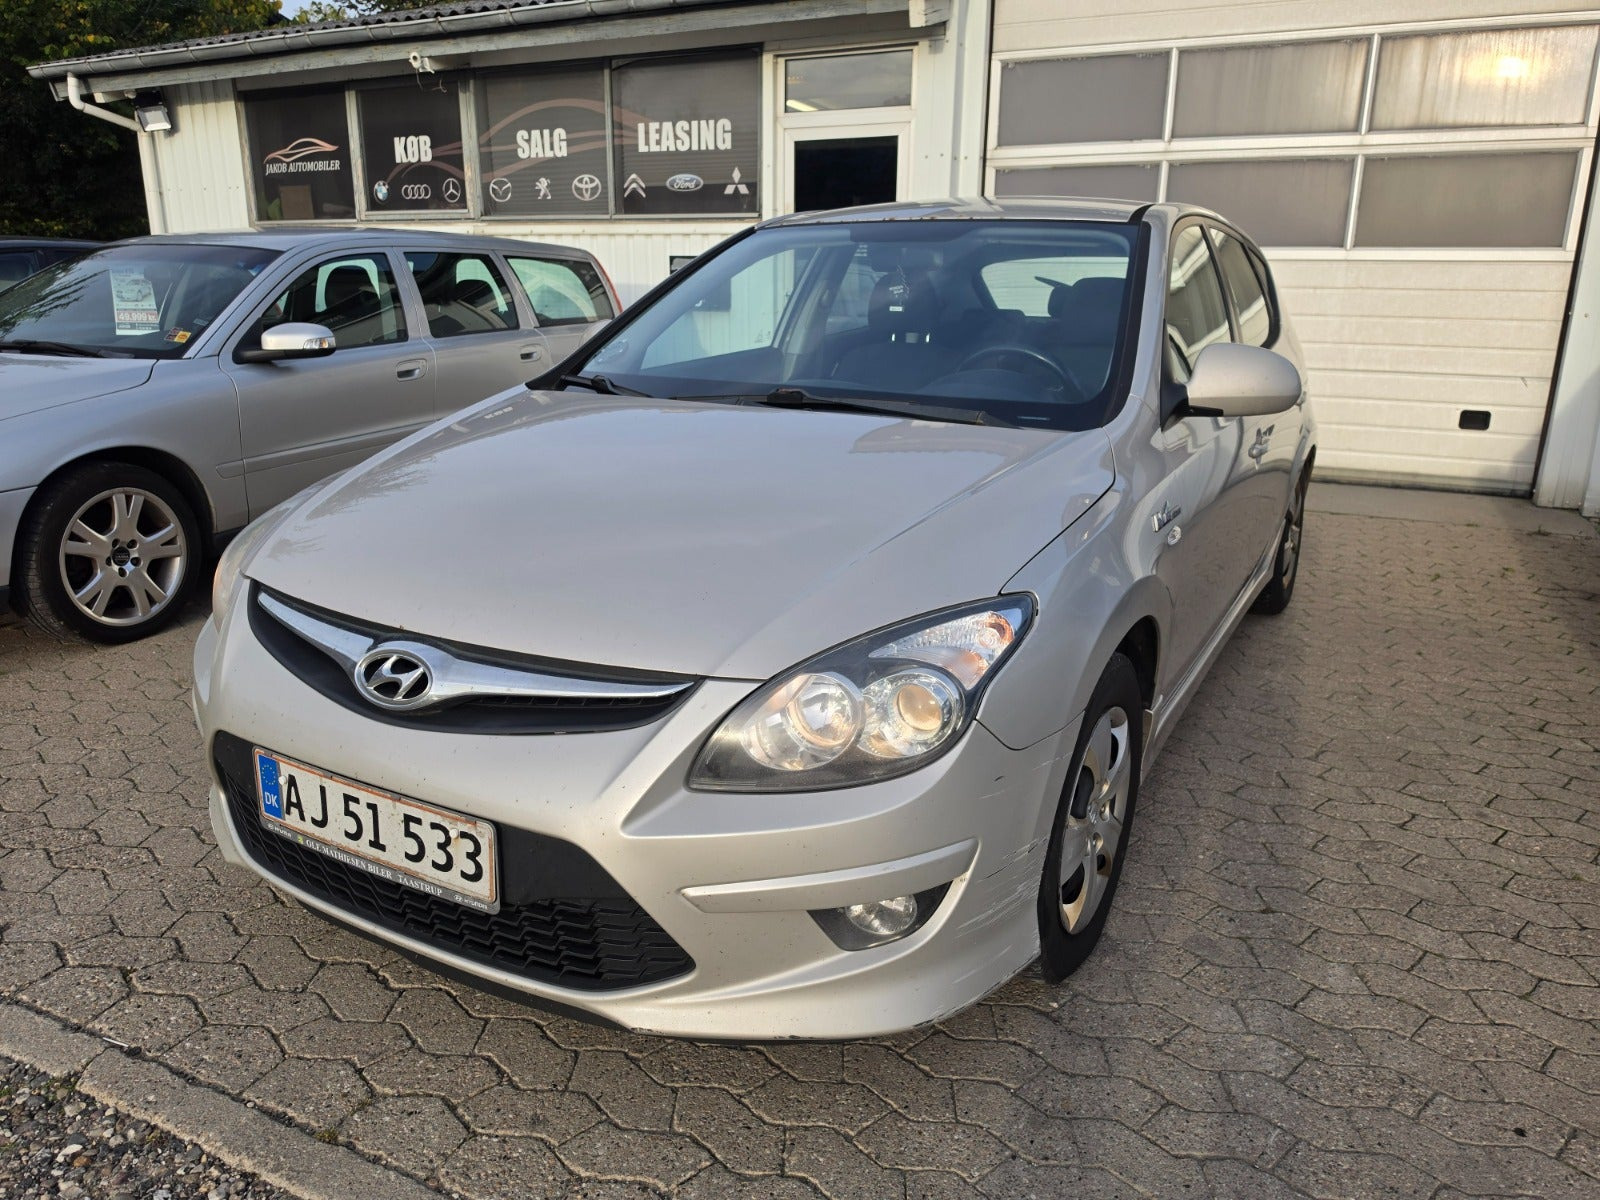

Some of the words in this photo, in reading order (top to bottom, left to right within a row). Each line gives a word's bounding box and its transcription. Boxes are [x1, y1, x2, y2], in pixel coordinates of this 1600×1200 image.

[394, 135, 433, 164] KØB
[516, 127, 568, 159] SALG
[637, 118, 732, 153] LEASING
[265, 161, 288, 176] JAKOB
[288, 160, 341, 173] AUTOMOBILER
[673, 176, 697, 190] Ford
[264, 791, 279, 809] DK
[285, 774, 329, 829] AJ
[342, 793, 387, 853] 51
[403, 813, 484, 883] 533
[306, 840, 322, 854] OLE
[322, 846, 366, 870] MATHIESEN
[367, 863, 393, 880] BILER
[398, 874, 443, 896] TAASTRUP
